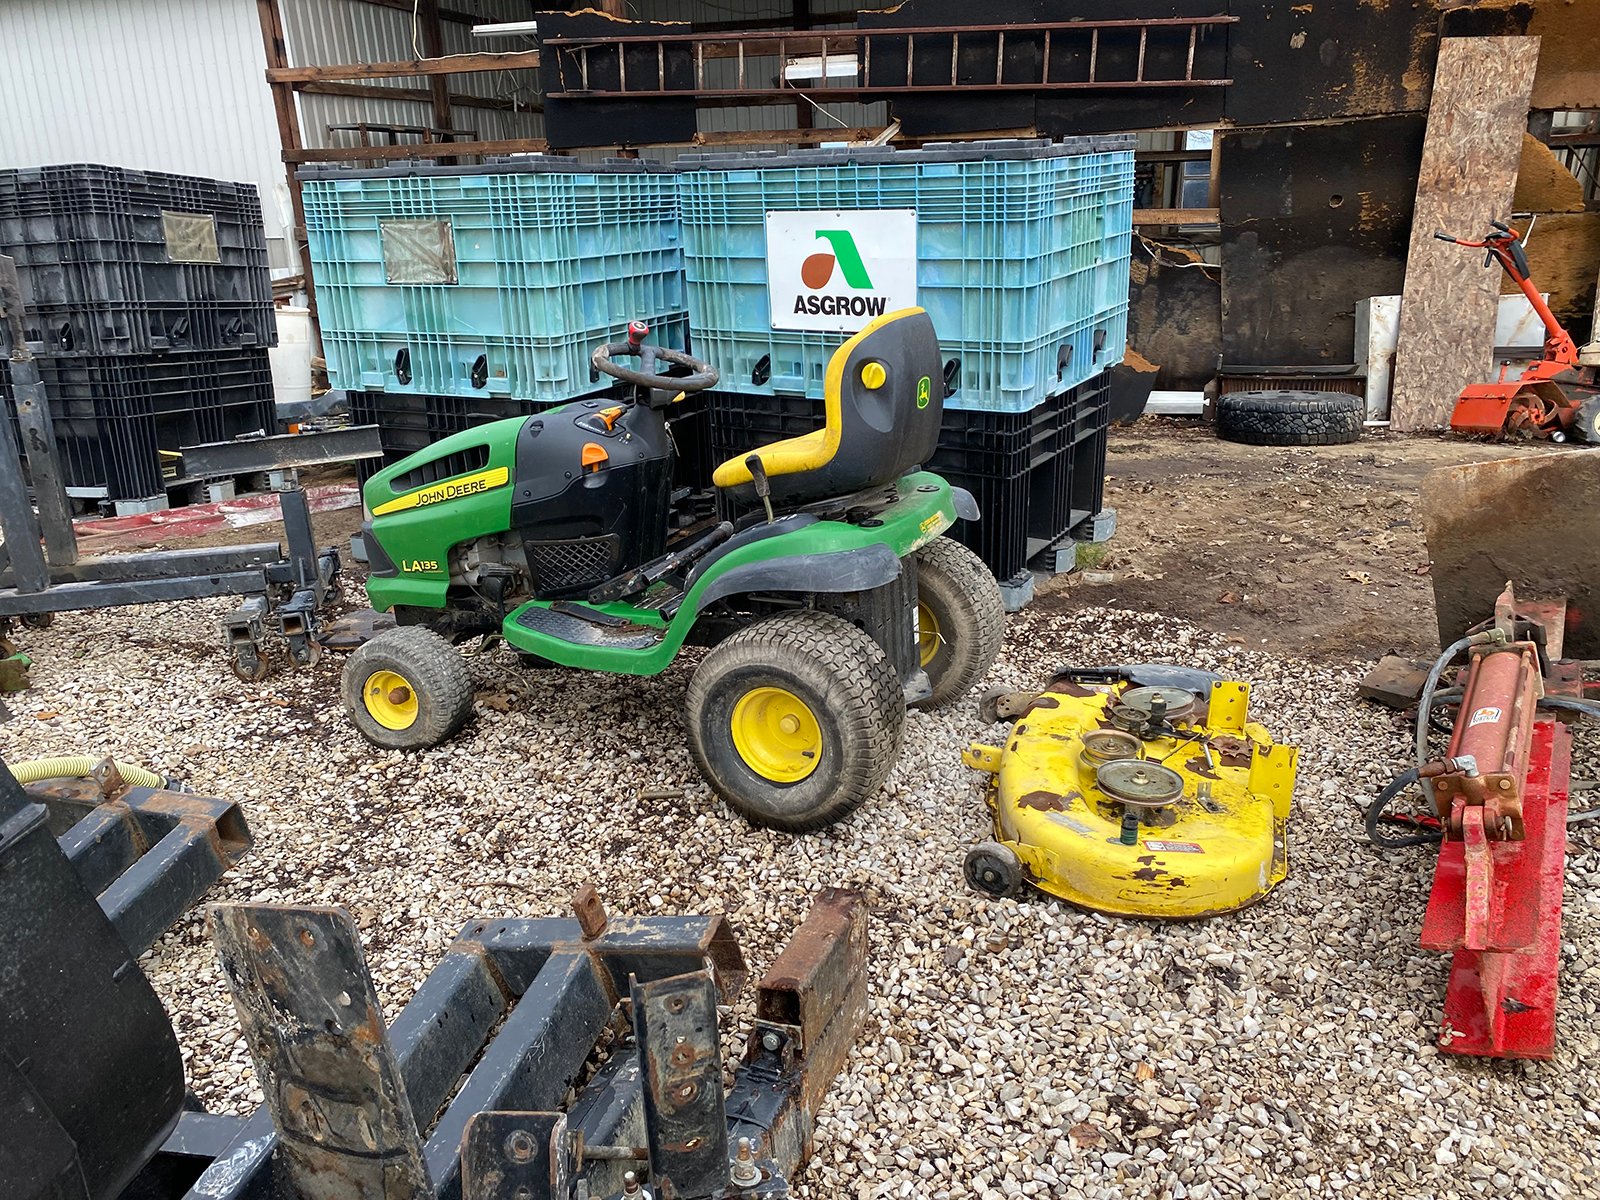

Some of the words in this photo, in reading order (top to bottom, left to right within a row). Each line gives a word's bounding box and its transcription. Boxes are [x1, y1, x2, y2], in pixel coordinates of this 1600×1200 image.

[793, 294, 887, 317] ASGROW
[415, 489, 445, 506] JOHN
[446, 479, 487, 498] DEERE
[402, 559, 438, 572] LA135
